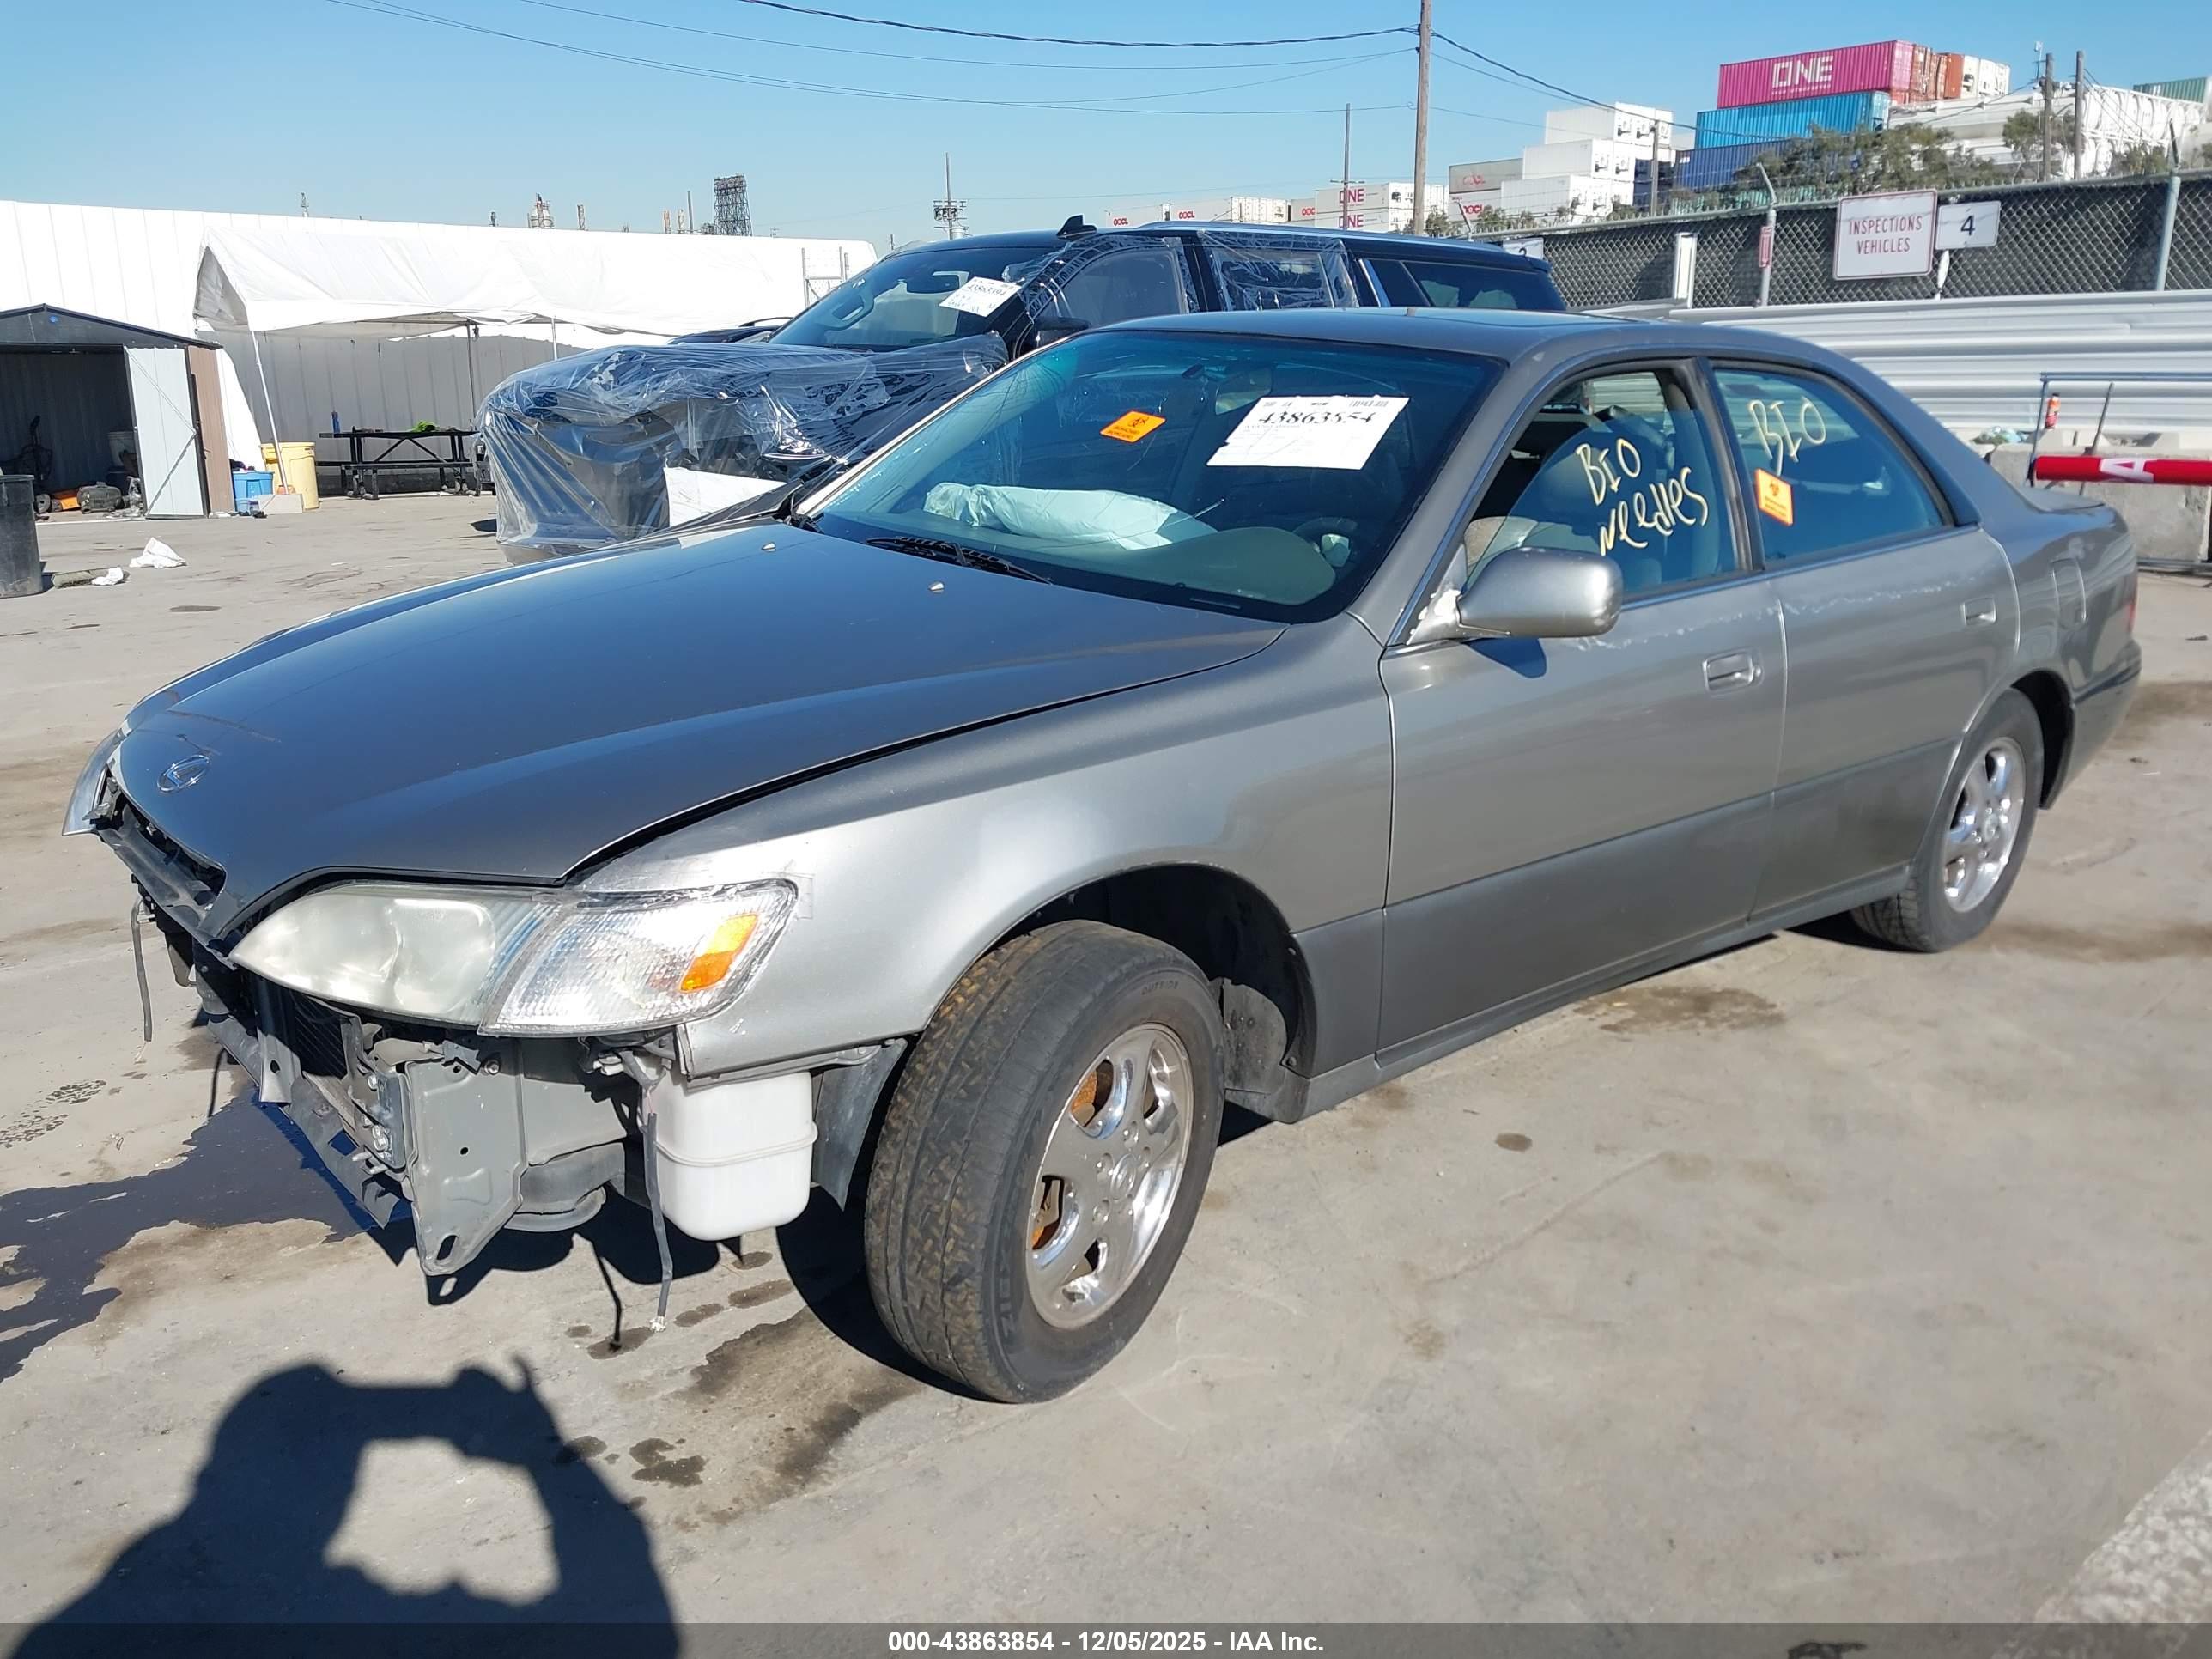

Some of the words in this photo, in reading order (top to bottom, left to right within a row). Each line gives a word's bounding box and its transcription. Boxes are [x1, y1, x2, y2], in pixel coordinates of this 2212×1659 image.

[1772, 56, 1833, 88] ONE
[1114, 217, 1128, 227] OOCL
[1179, 210, 1195, 219] OOCL
[1849, 216, 1923, 235] INSPECTIONS
[1960, 216, 1976, 236] 4
[1857, 237, 1911, 255] VEHICLES
[1747, 396, 1826, 476] BIO
[1575, 437, 1642, 507] BIO
